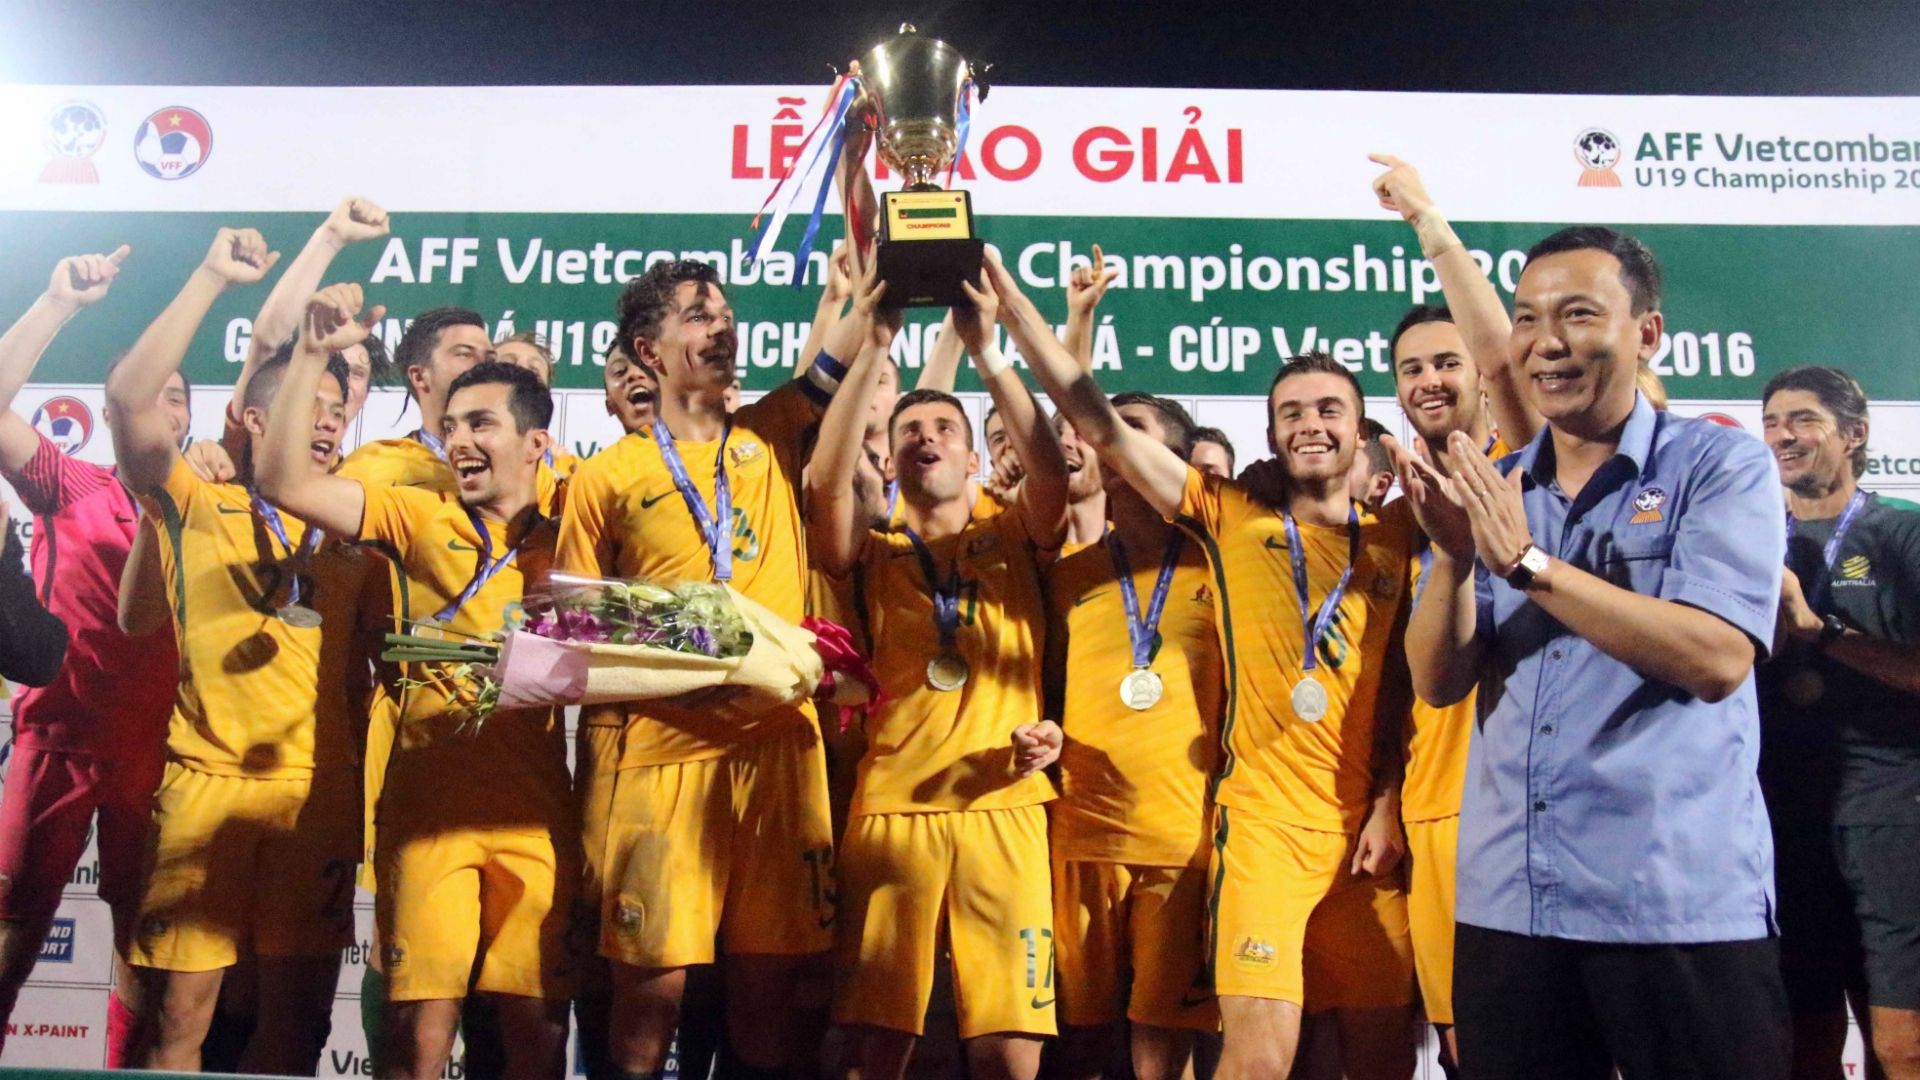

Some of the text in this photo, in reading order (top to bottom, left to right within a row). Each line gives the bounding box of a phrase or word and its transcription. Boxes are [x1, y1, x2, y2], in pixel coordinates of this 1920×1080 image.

[1072, 106, 1244, 184] GIẢI
[1634, 132, 1703, 161] AFF
[160, 161, 183, 171] VFF
[1635, 167, 1686, 187] U19
[1694, 167, 1886, 194] Championship
[906, 222, 952, 230] CHAMPIONS
[369, 237, 480, 284] AFF
[496, 237, 846, 286] Vietcmban
[1018, 240, 1442, 305] Championship
[1169, 316, 1262, 372] CÚP
[1648, 331, 1756, 377] 2016
[1831, 579, 1876, 587] AUSTRALIA
[1019, 928, 1053, 988] 17
[23, 1024, 89, 1039] X-PAINT
